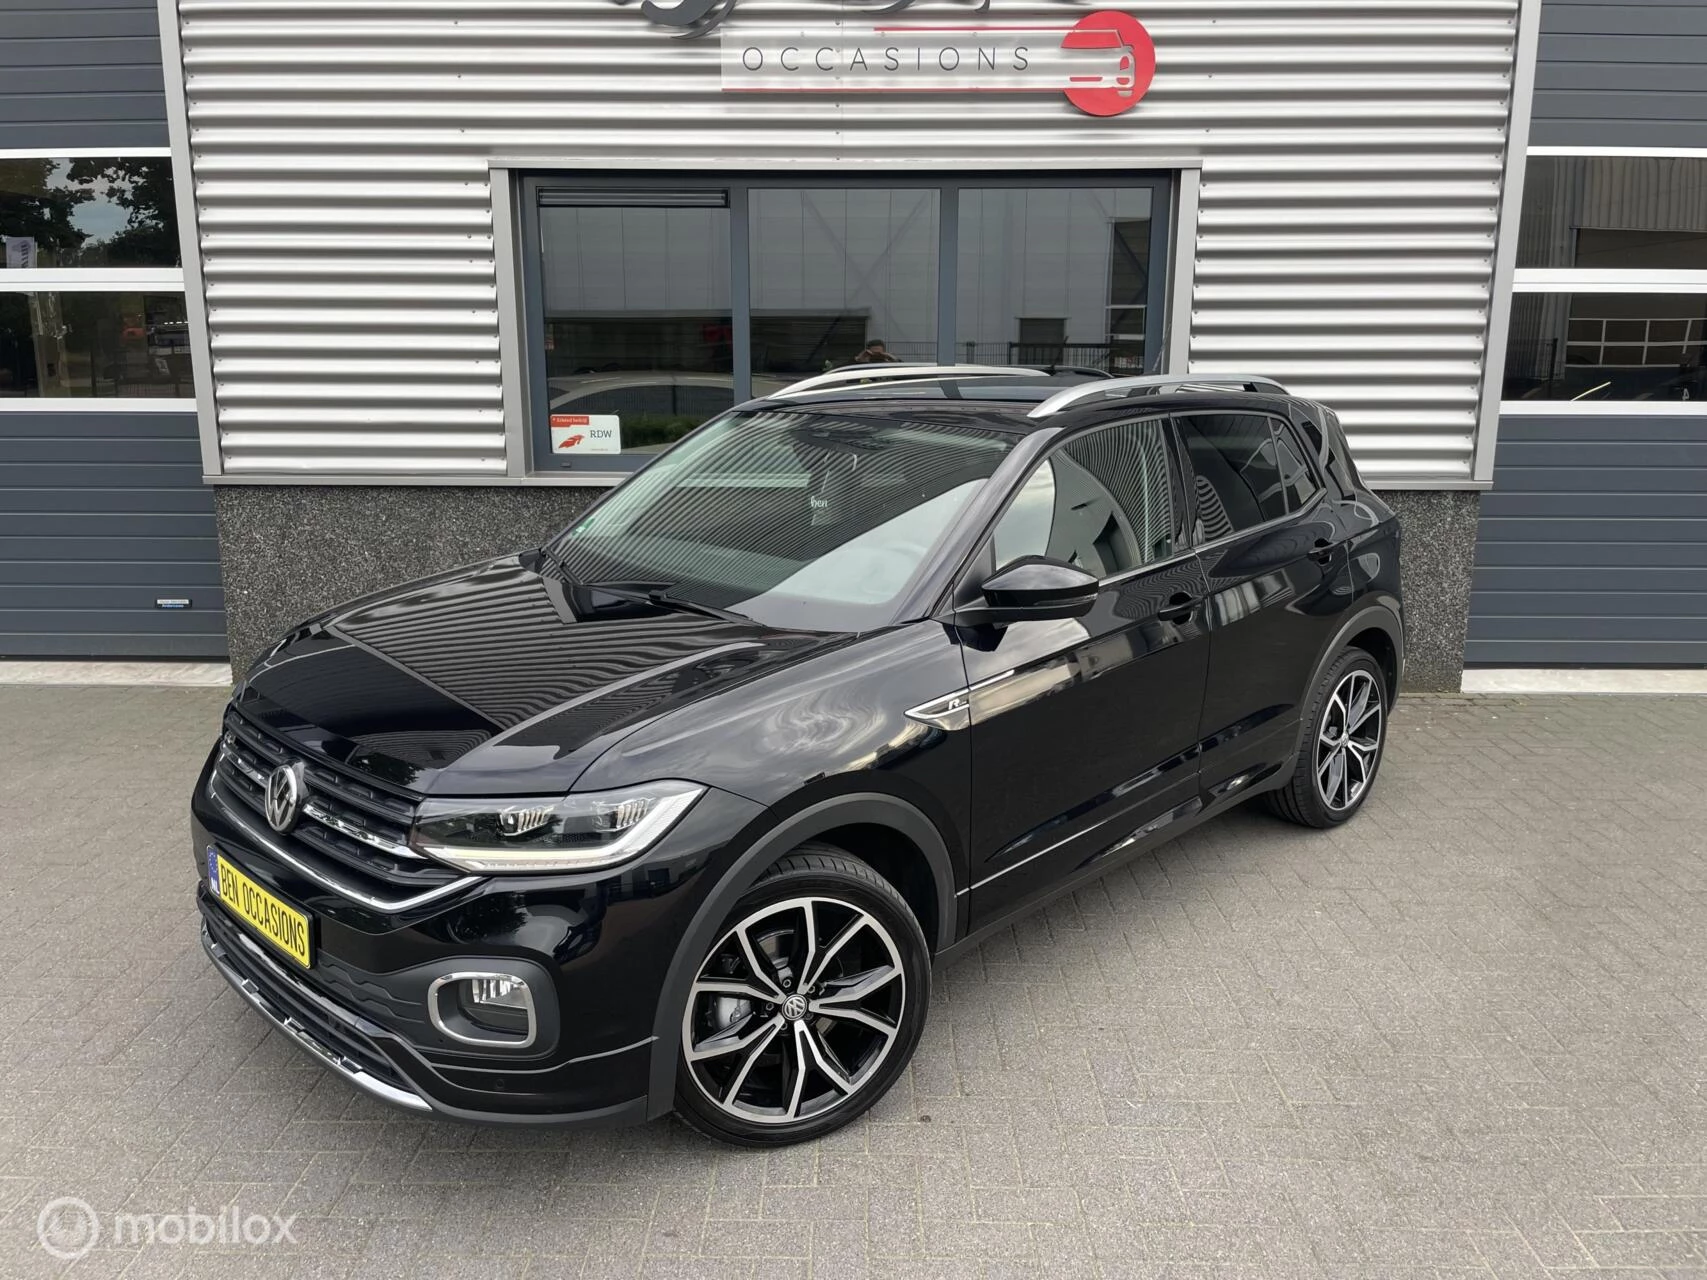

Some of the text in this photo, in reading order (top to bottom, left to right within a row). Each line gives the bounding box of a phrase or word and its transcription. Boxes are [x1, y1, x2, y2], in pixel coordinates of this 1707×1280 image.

[741, 46, 1030, 72] OCCASIONS
[589, 429, 613, 439] RDW
[220, 863, 305, 957] BEN OCCASIONS
